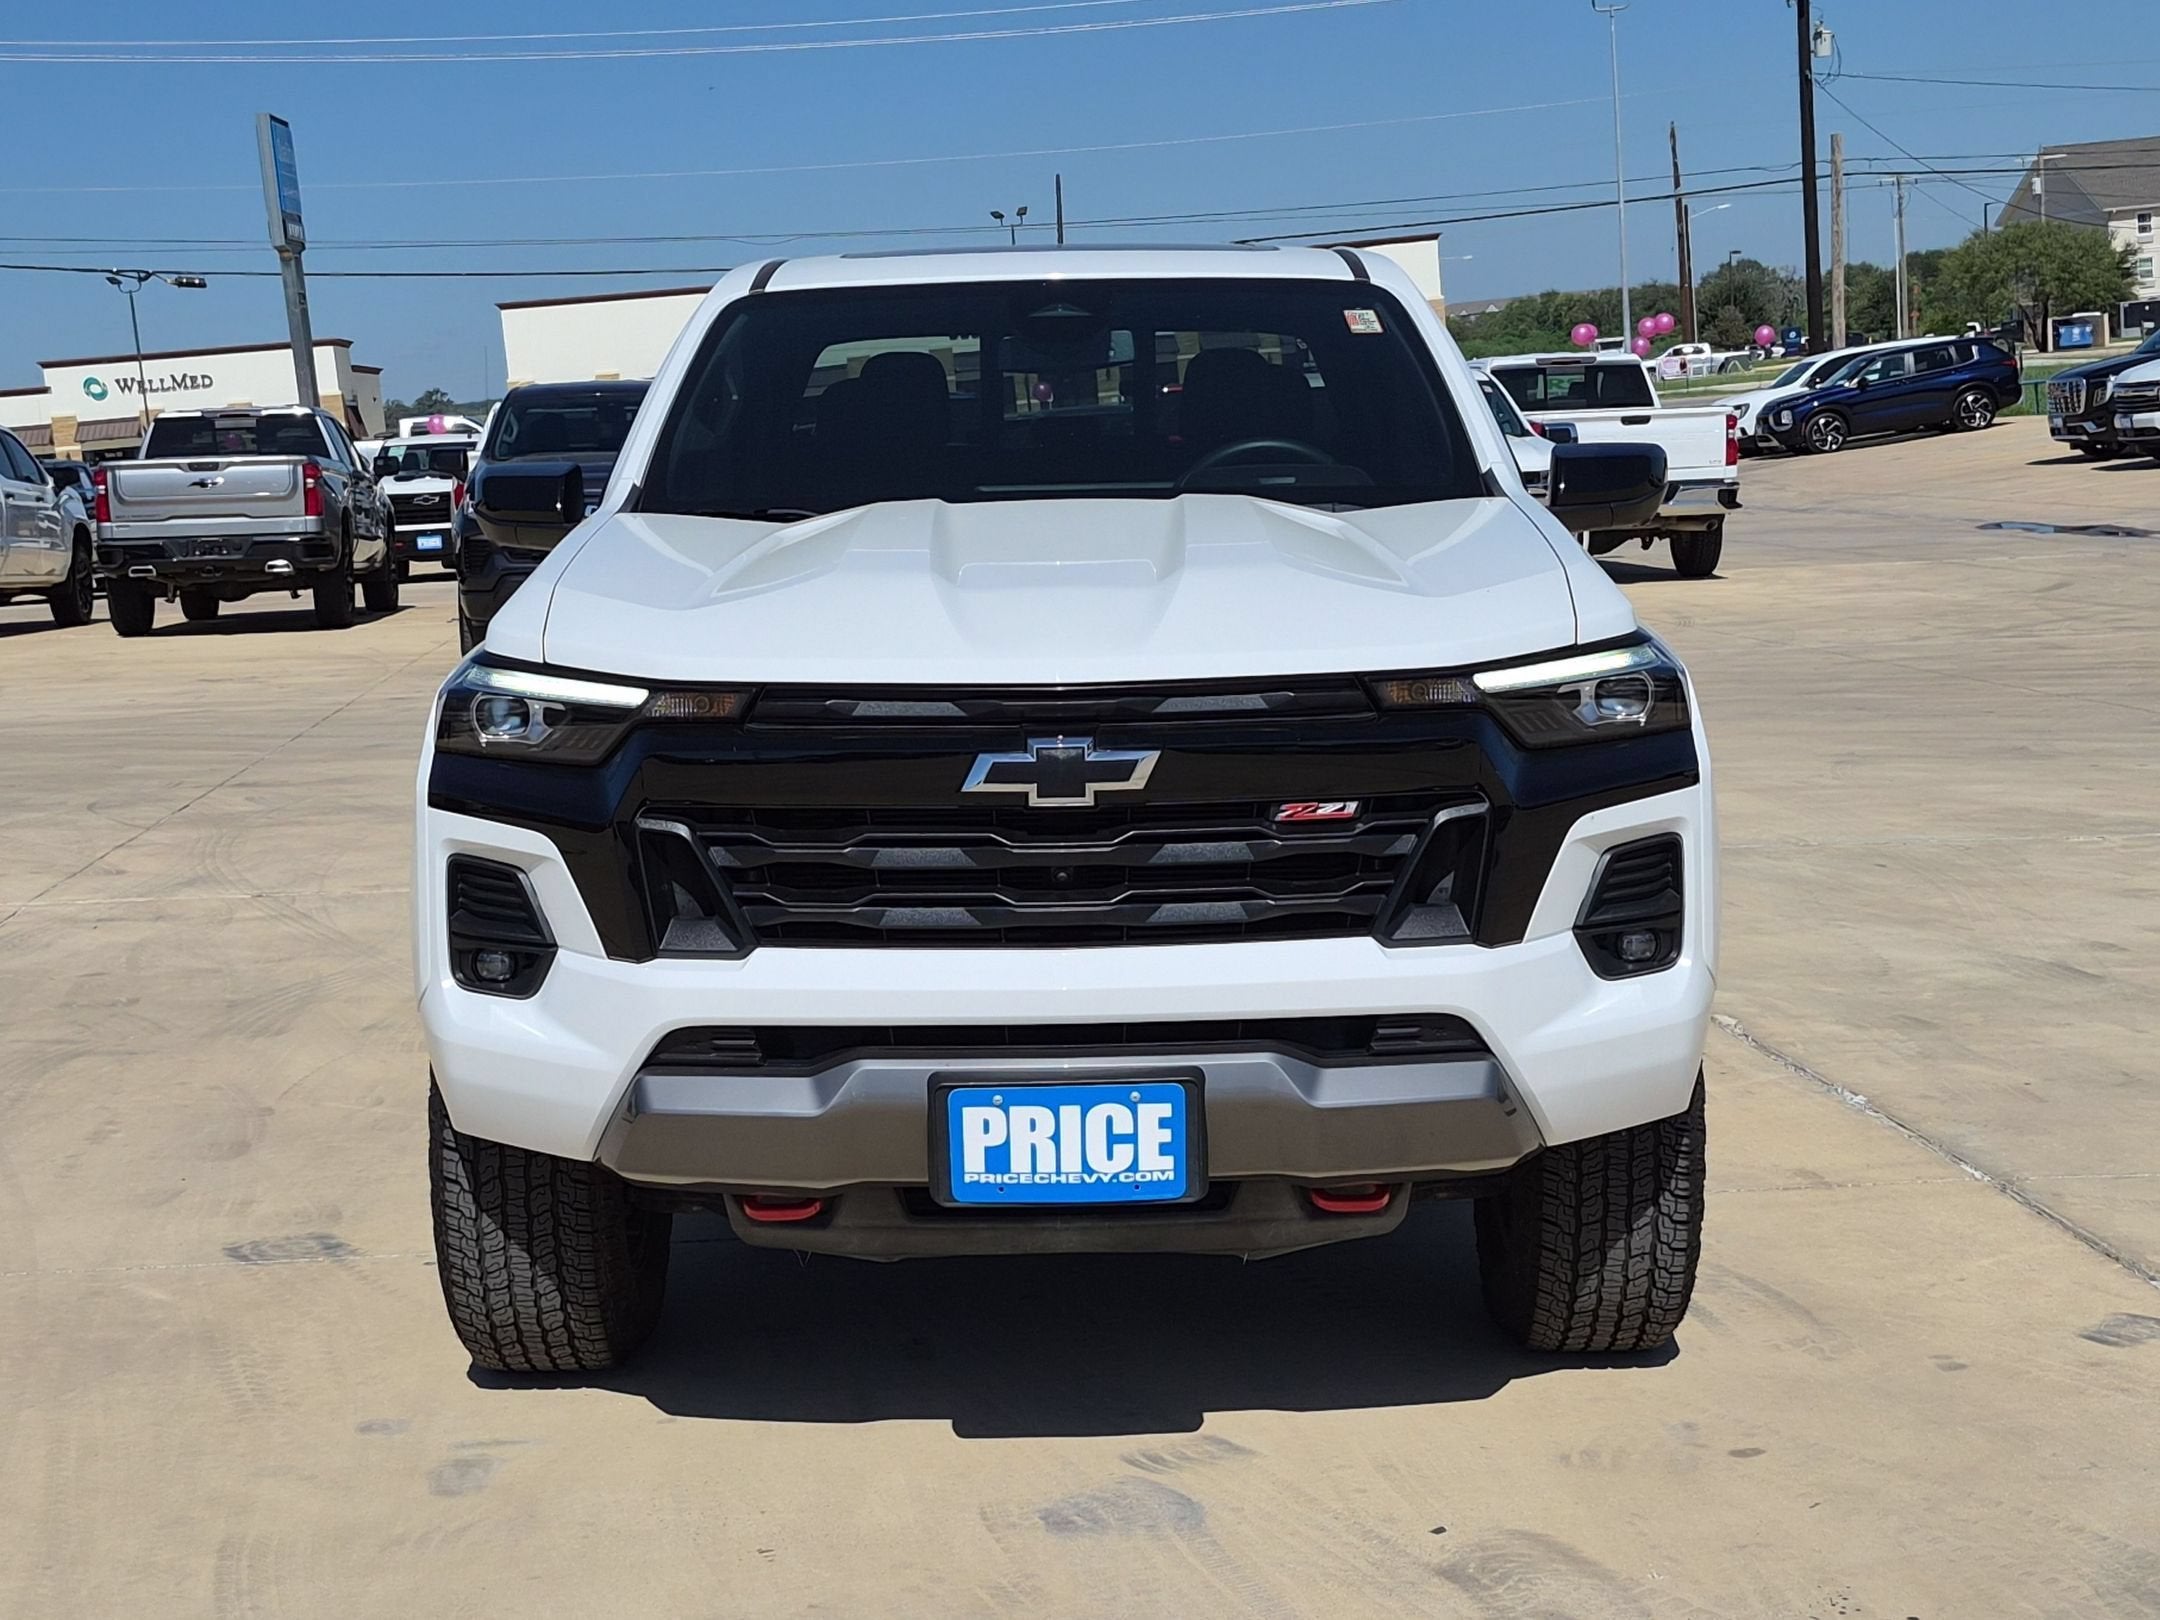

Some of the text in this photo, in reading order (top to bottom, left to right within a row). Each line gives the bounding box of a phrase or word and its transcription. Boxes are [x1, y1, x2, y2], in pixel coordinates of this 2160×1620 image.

[1275, 801, 1359, 820] Z71
[962, 1103, 1174, 1173] PRICE
[964, 1170, 1174, 1184] PRICECHEVY.COM
